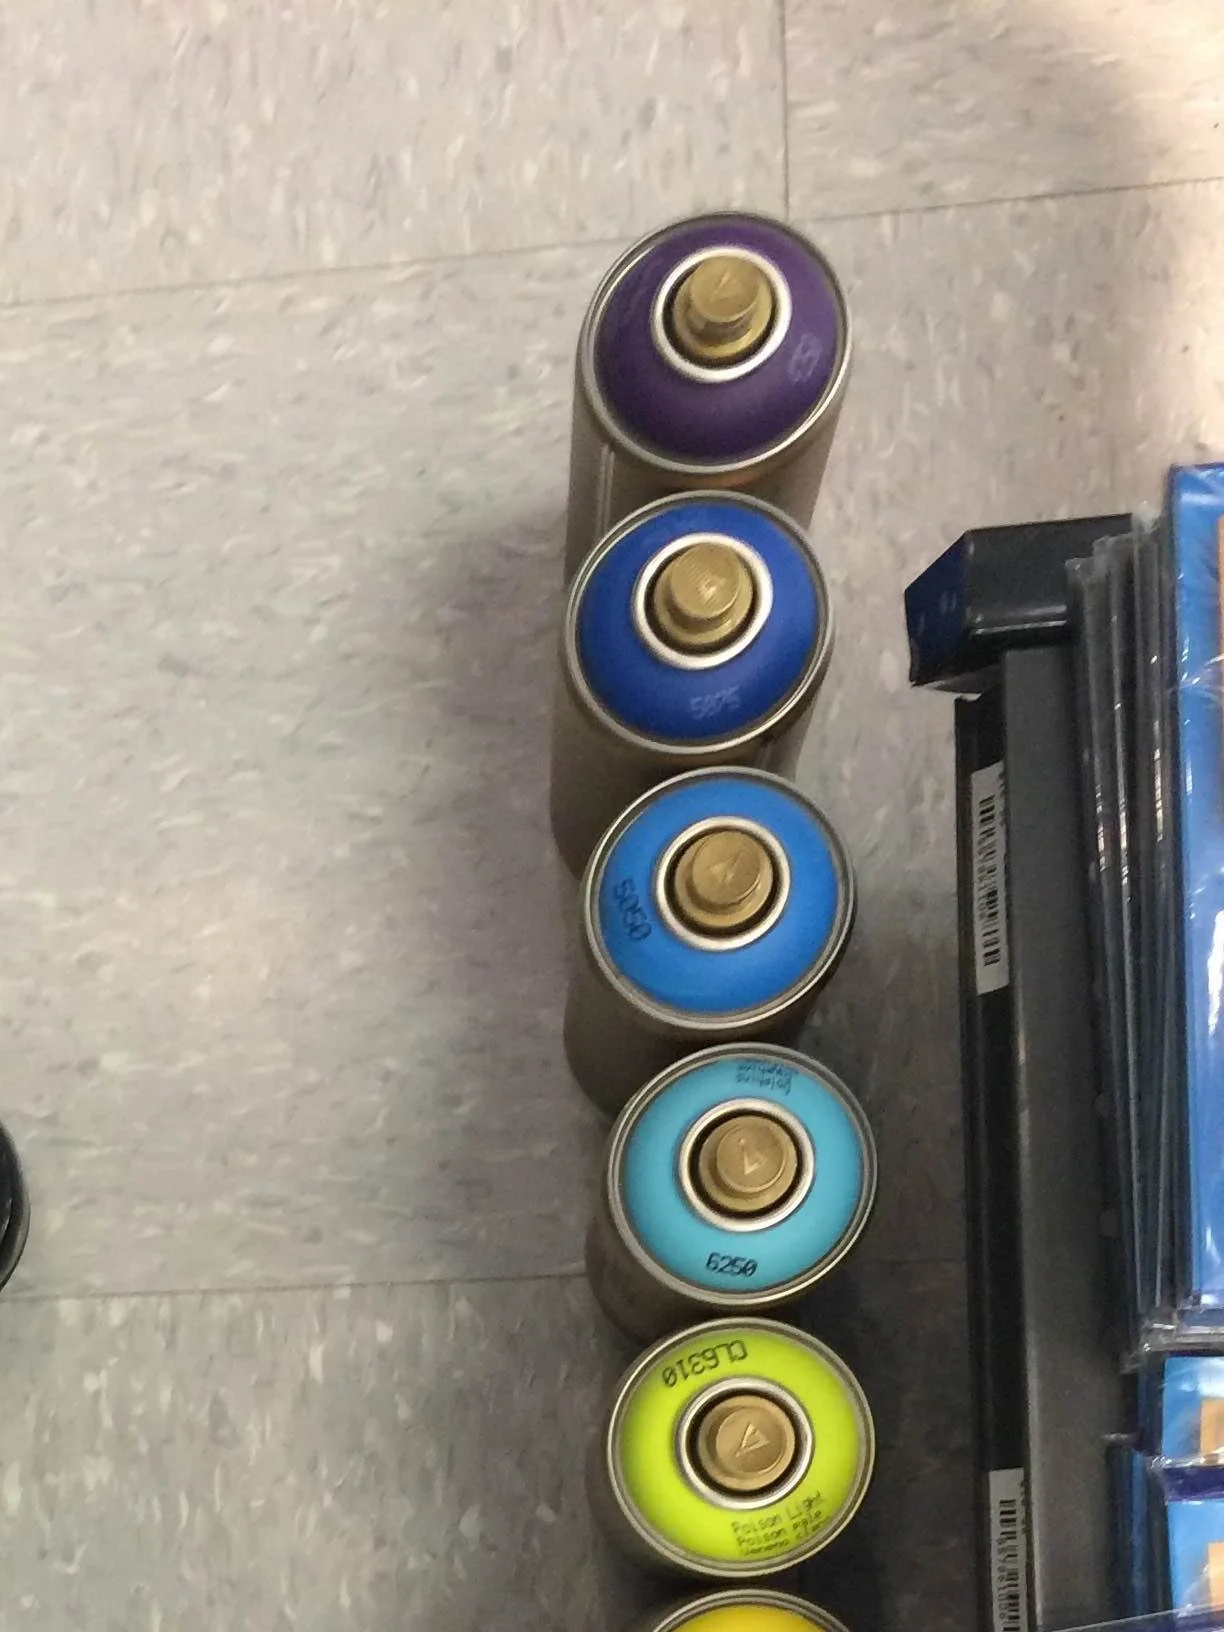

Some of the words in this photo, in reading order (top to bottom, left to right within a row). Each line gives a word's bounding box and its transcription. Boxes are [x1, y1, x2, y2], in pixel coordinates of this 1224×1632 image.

[613, 877, 653, 941] 5050
[705, 1252, 758, 1277] 6250
[661, 1338, 749, 1388] CL6310
[730, 1512, 784, 1536] Poison
